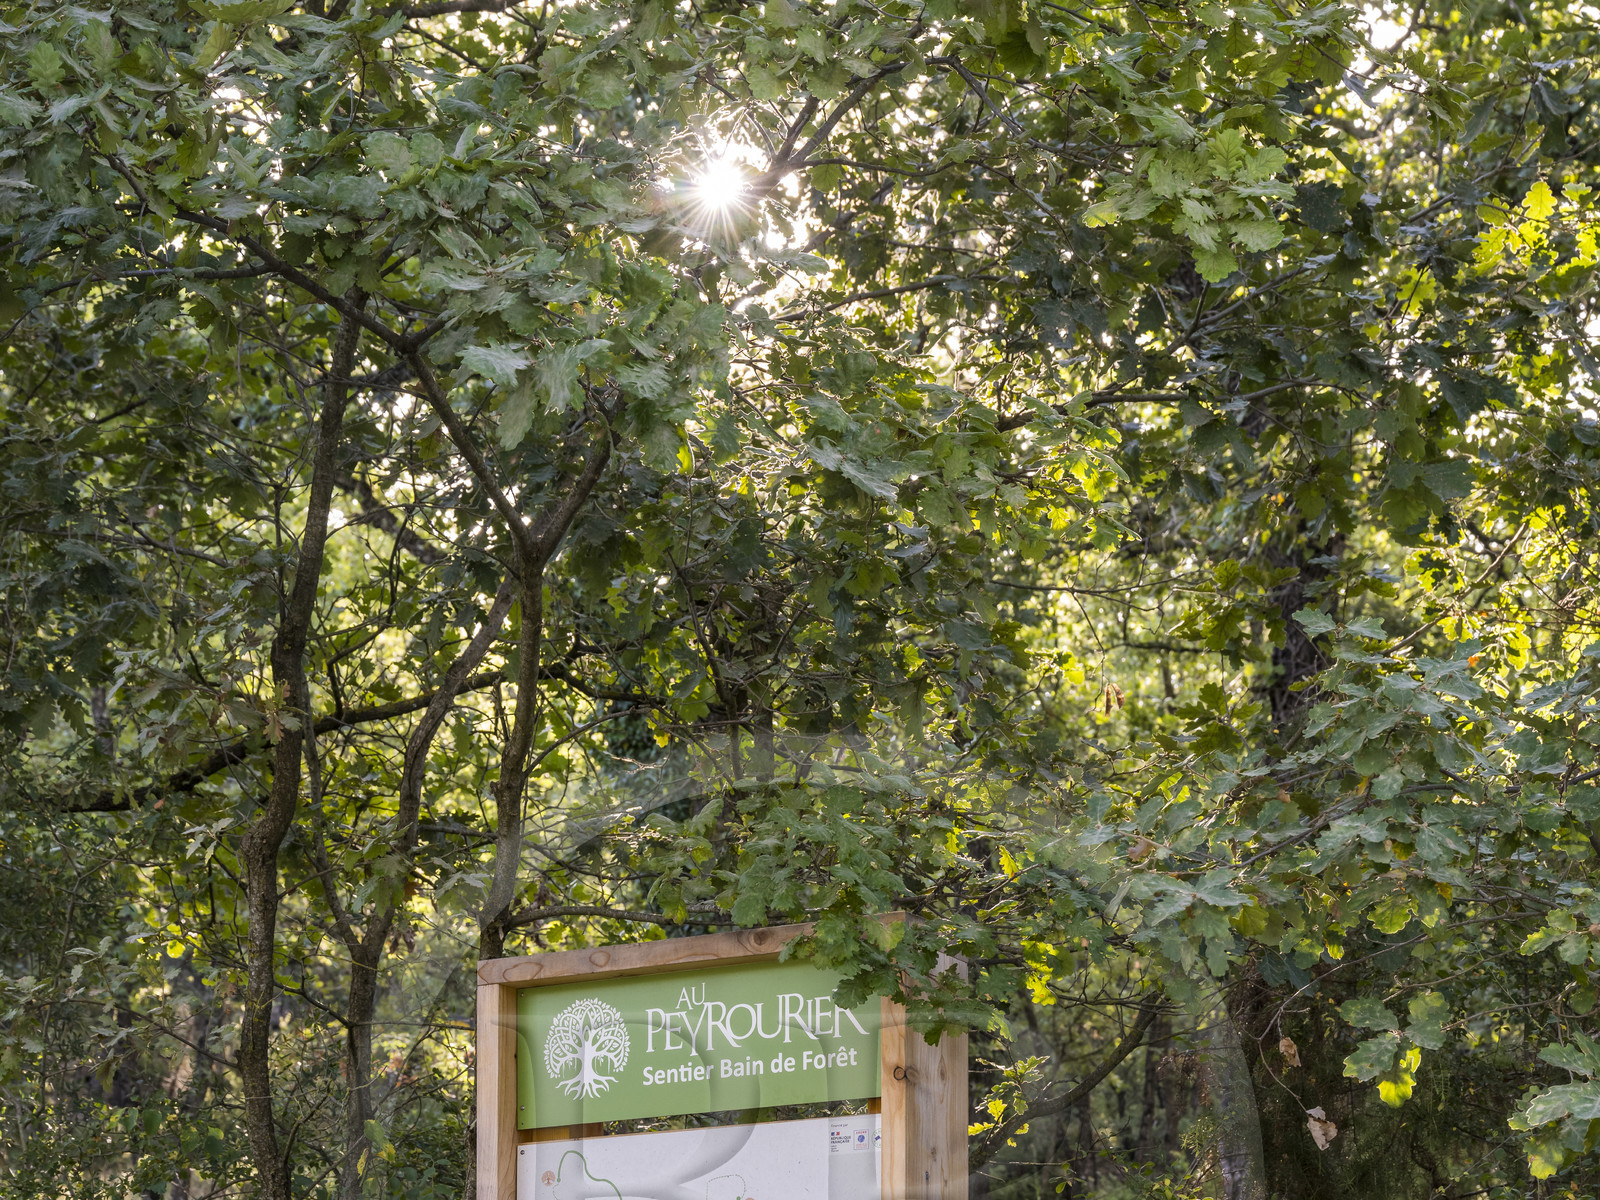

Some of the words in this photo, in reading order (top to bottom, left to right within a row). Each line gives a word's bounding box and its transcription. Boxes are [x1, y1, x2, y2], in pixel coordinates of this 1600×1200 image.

[676, 982, 706, 1010] AU
[642, 1064, 714, 1086] Sentier
[720, 1058, 764, 1080] Bain
[770, 1052, 796, 1074] de
[803, 1046, 858, 1070] Forêt
